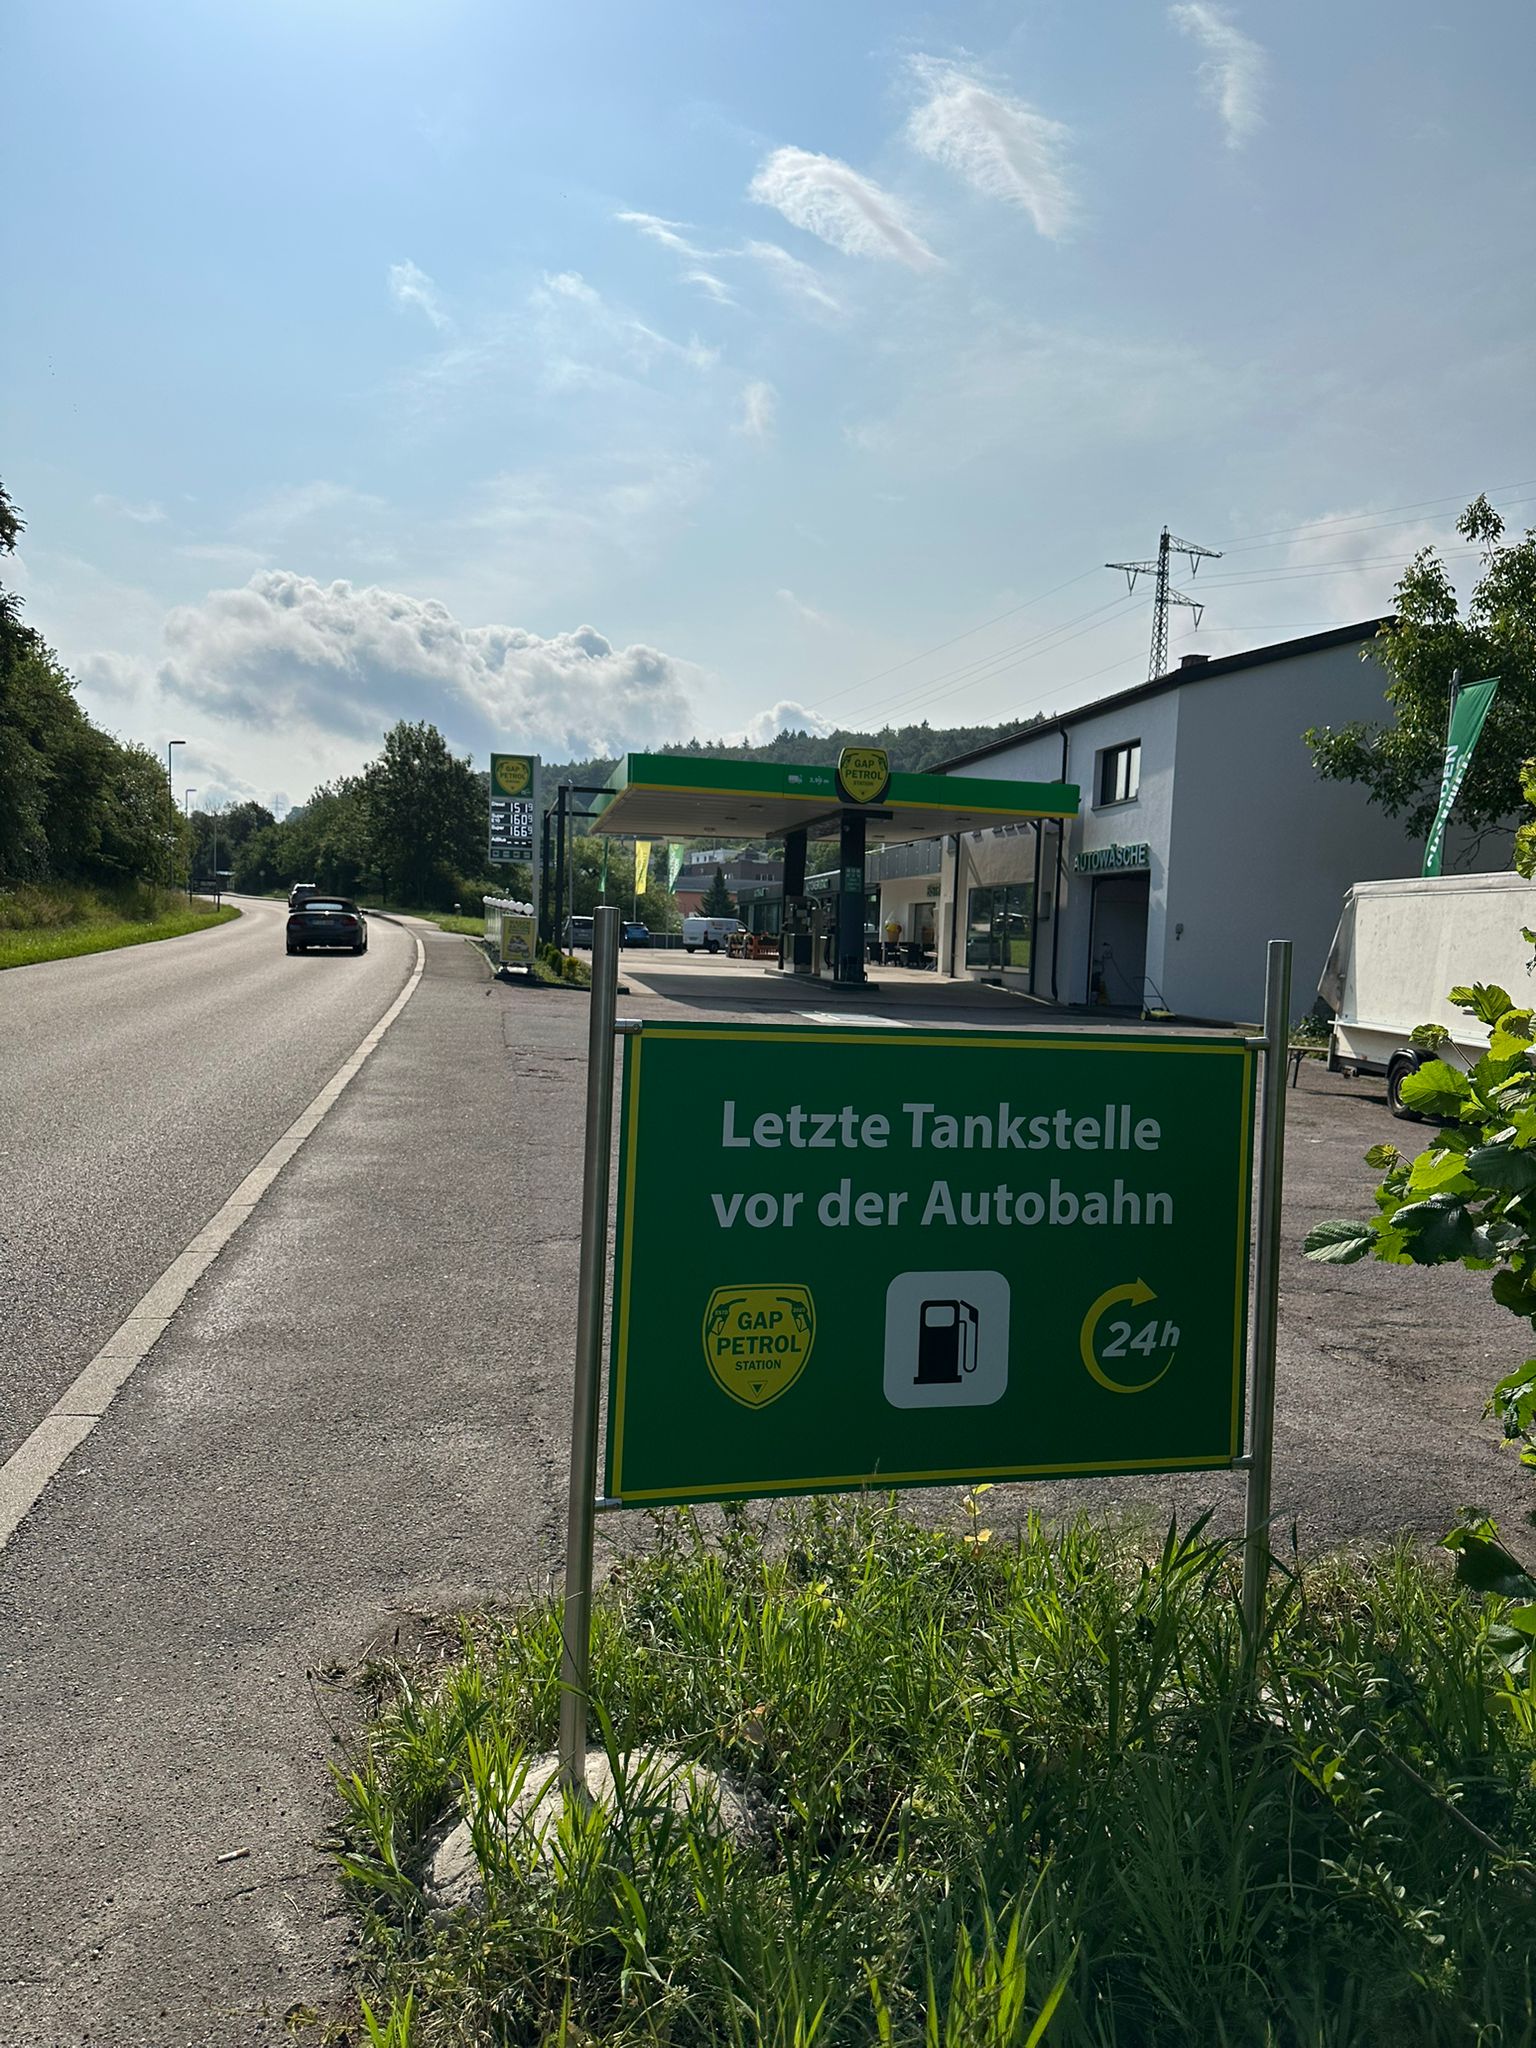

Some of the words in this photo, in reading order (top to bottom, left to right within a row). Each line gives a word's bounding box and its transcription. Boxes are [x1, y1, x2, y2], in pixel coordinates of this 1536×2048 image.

[854, 759, 875, 769] GAP
[499, 772, 526, 780] PETROL
[845, 769, 883, 781] PETROL
[1073, 843, 1148, 872] AUTOWÄSCHE
[722, 1100, 891, 1148] Letzte
[902, 1102, 1162, 1150] Tankstelle
[711, 1193, 805, 1228] vor
[818, 1178, 909, 1227] der
[920, 1179, 1175, 1226] Autobahn
[737, 1311, 784, 1330] GAP
[716, 1334, 802, 1356] PETROL
[1100, 1321, 1182, 1358] 24h
[735, 1359, 782, 1371] STATION
